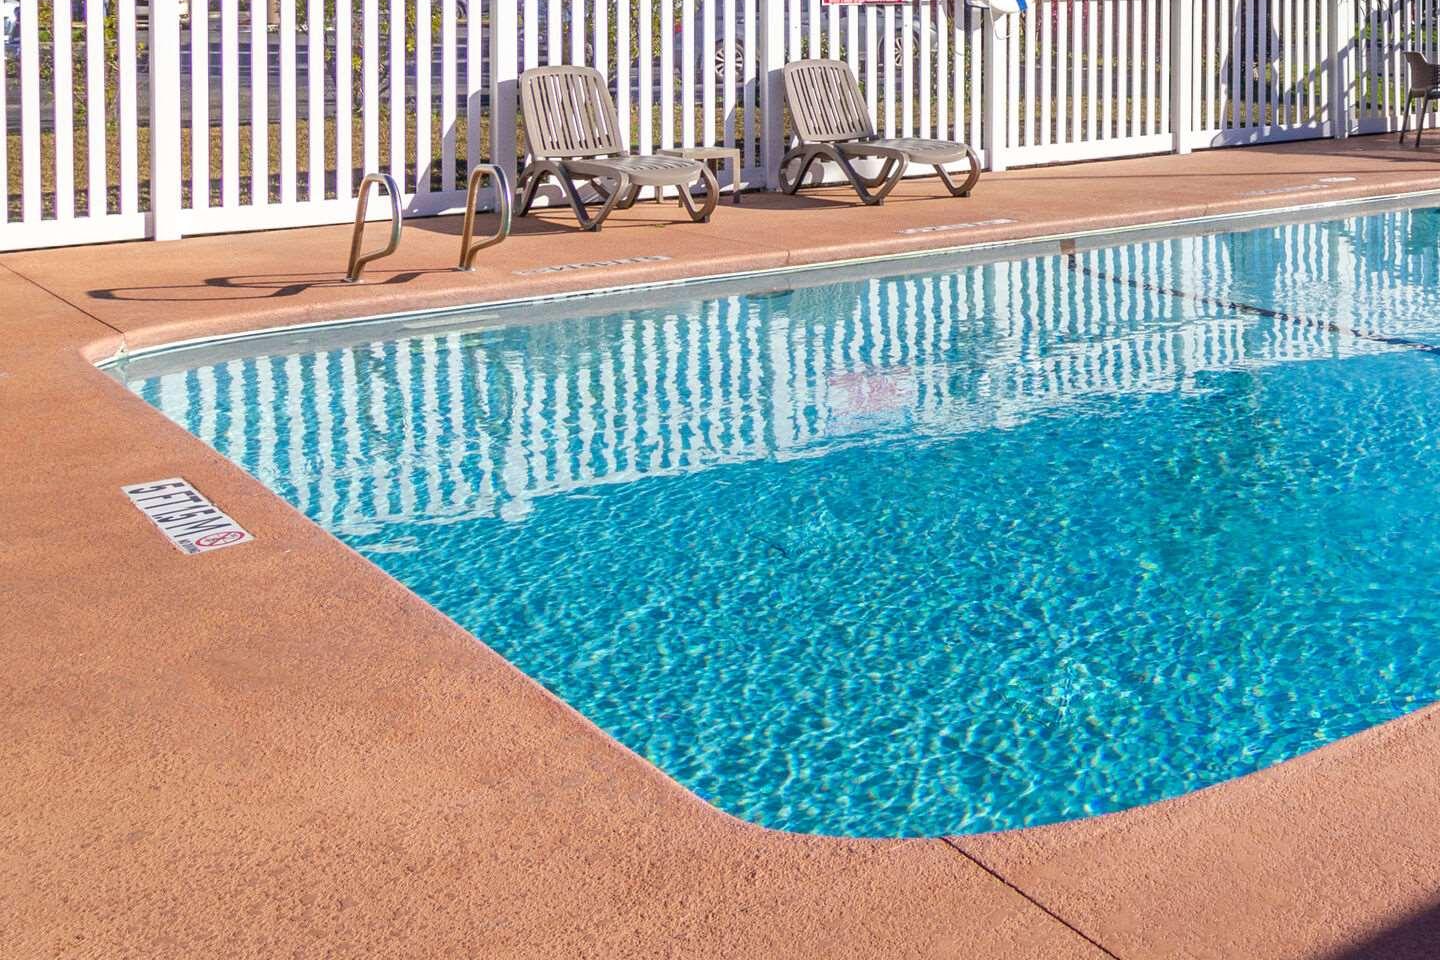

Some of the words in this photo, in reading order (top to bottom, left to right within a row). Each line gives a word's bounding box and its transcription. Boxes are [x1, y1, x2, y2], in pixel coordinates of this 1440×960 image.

[128, 482, 185, 494] 5
[137, 490, 203, 509] FT
[152, 504, 217, 523] 1.5
[165, 516, 233, 537] M
